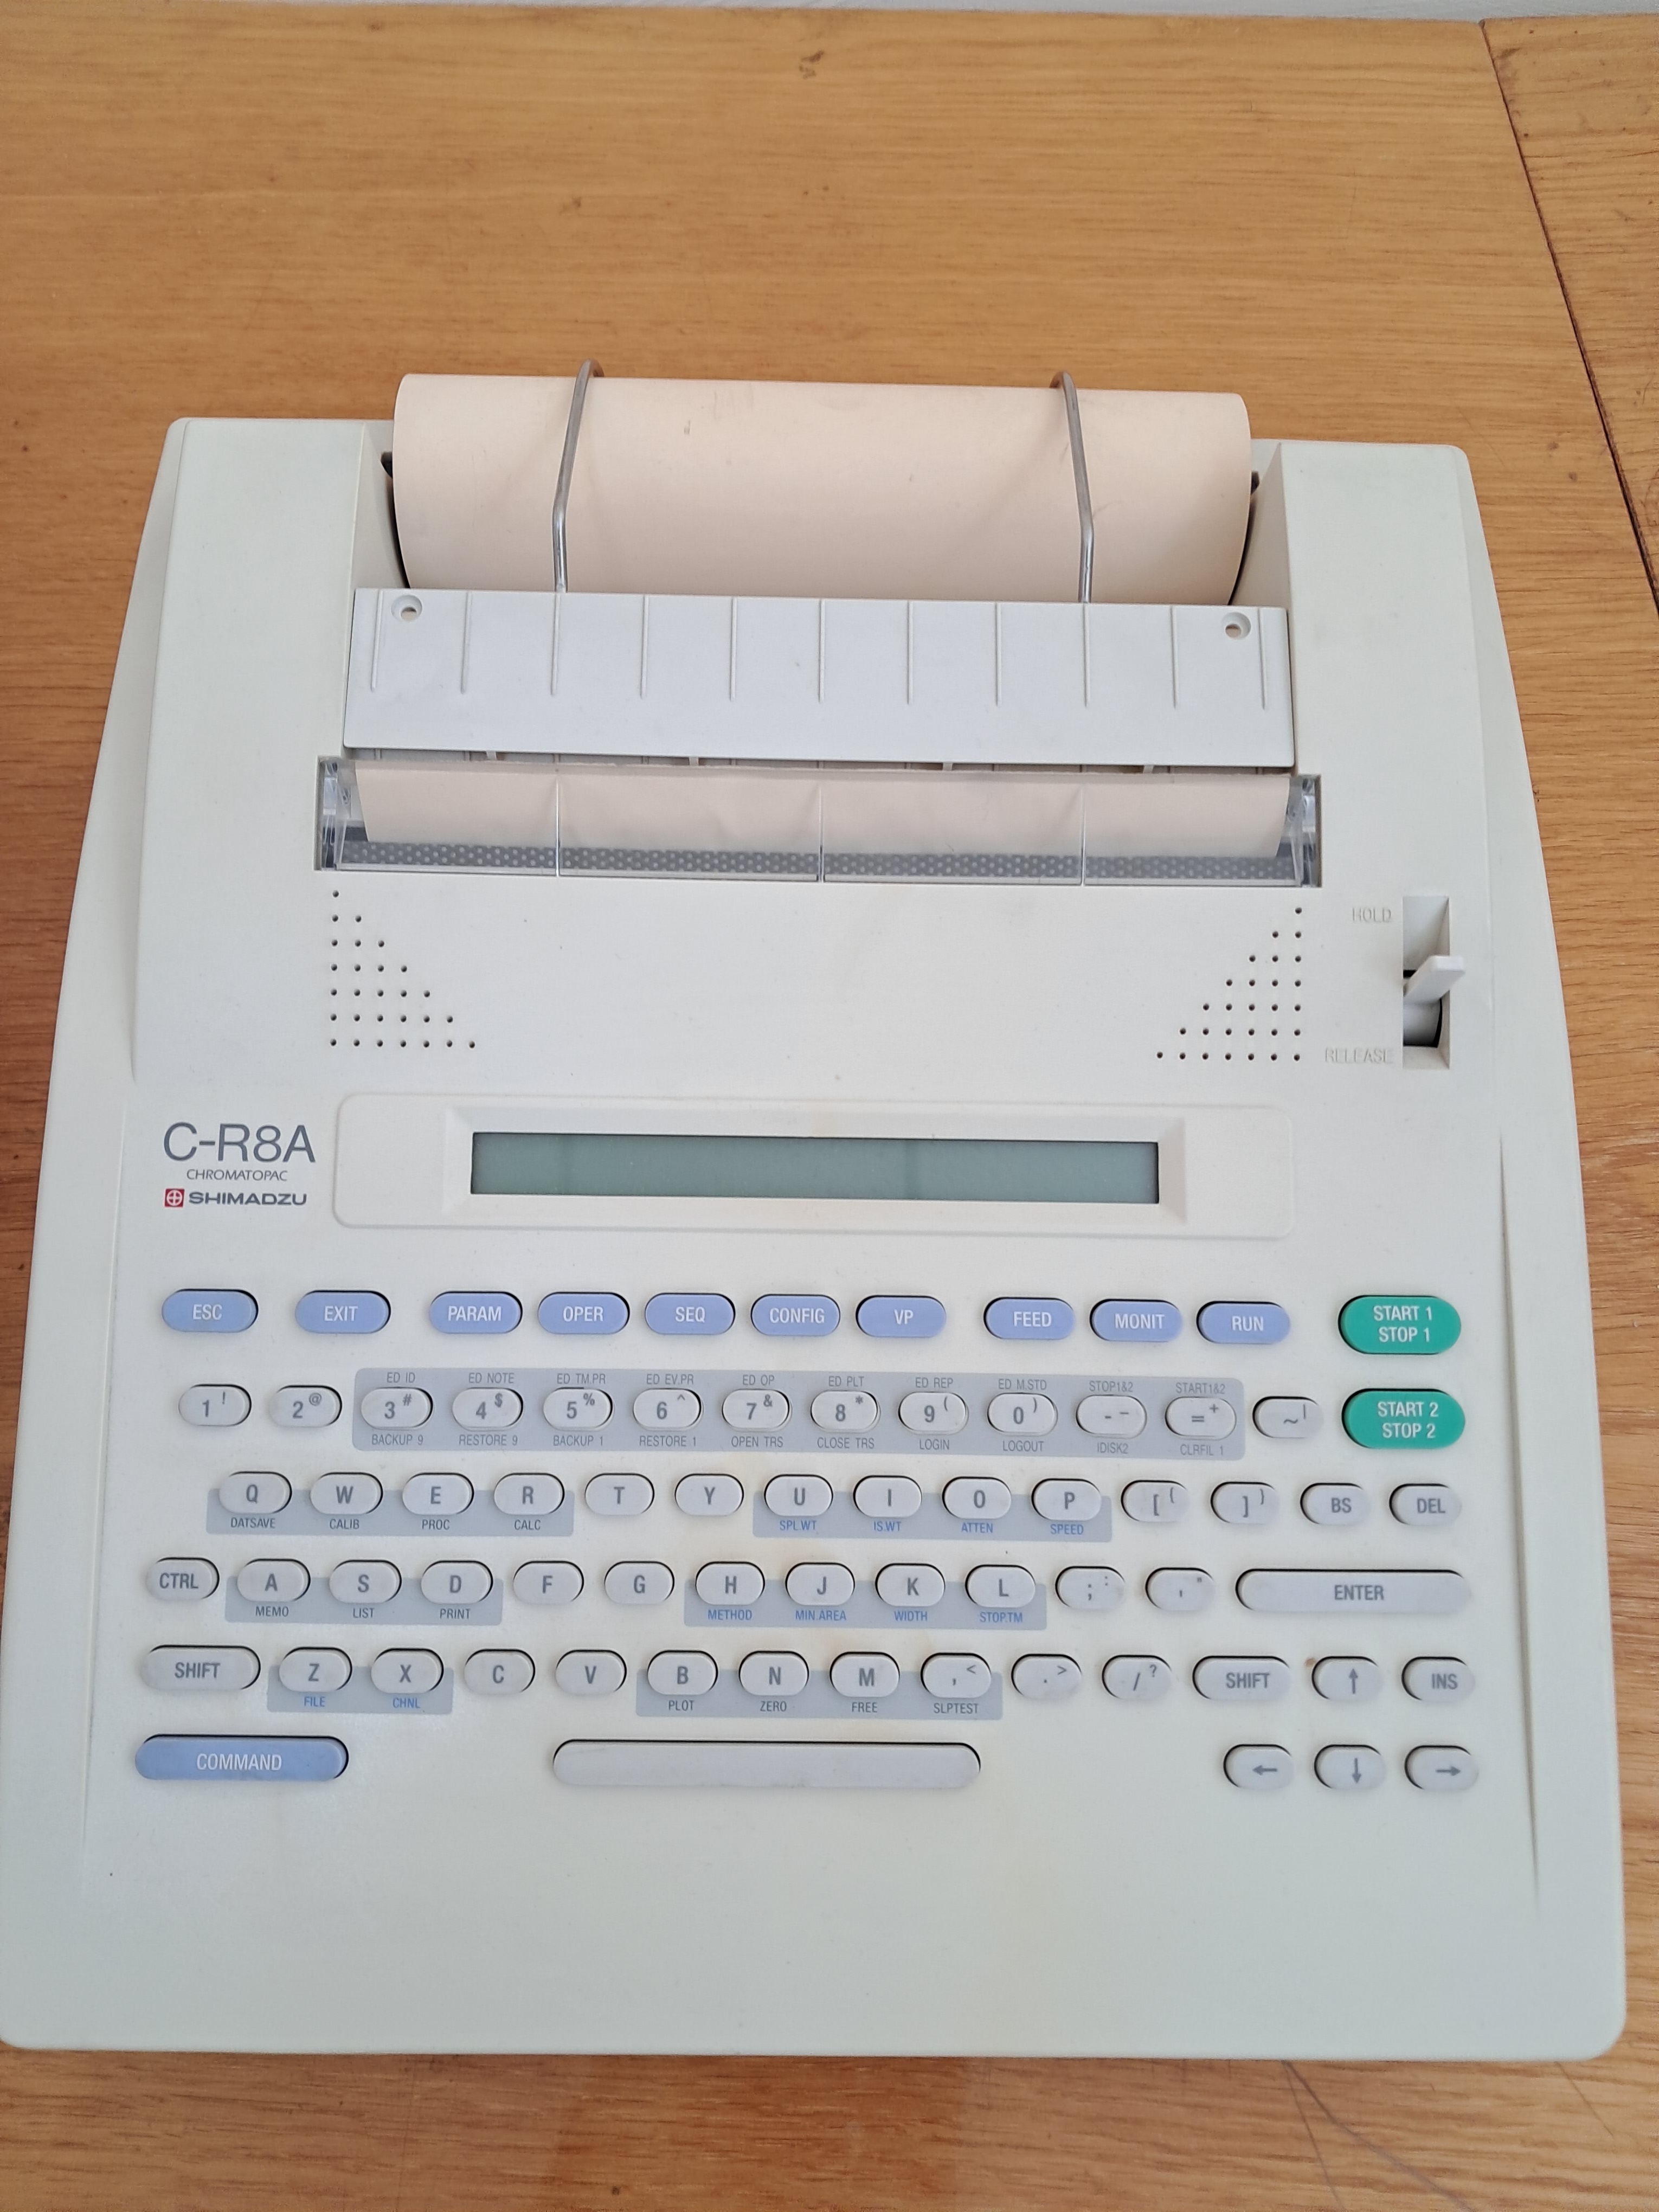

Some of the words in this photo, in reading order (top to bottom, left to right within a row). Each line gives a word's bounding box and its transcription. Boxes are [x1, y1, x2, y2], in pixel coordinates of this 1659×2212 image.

[1352, 907, 1391, 923] HOLD
[1325, 1047, 1393, 1063] RELEASE
[164, 1122, 316, 1162] C-R8A
[187, 1168, 288, 1181] CHROMATOPAC
[189, 1192, 307, 1205] SHIMADZU
[192, 1304, 222, 1321] ESC
[325, 1306, 358, 1322] EXIT
[448, 1306, 501, 1322] PARAM
[563, 1306, 604, 1322] OPER
[675, 1307, 706, 1323] SEQ
[769, 1308, 825, 1324] CONFIG
[894, 1309, 914, 1324] VP
[1013, 1311, 1052, 1327] FEED
[1373, 1306, 1422, 1321] START
[1426, 1307, 1432, 1322] 1
[1115, 1313, 1165, 1330] MONIT
[1231, 1315, 1264, 1332] RUN
[1378, 1326, 1419, 1342] STOP
[1423, 1327, 1430, 1342] 1
[387, 1373, 401, 1383] ED
[405, 1373, 415, 1383] ID
[468, 1373, 483, 1383] ED
[487, 1373, 515, 1384] NOTE
[557, 1373, 571, 1384] ED
[646, 1374, 660, 1384] ED
[742, 1374, 756, 1385] ED
[761, 1374, 775, 1385] OP
[828, 1376, 843, 1387] ED
[846, 1377, 864, 1387] PLT
[915, 1378, 929, 1388] ED
[934, 1378, 954, 1388] REP
[998, 1379, 1012, 1390] ED
[1089, 1381, 1133, 1392] STOP1&2
[1175, 1382, 1225, 1394] START1&2
[201, 1400, 210, 1417] 1
[292, 1402, 304, 1419] 2
[384, 1402, 396, 1419] 3
[475, 1402, 487, 1419] 4
[567, 1401, 577, 1419] 5
[656, 1402, 667, 1419] 6
[746, 1402, 757, 1420] 7
[835, 1404, 846, 1422] 8
[924, 1405, 935, 1423] 9
[1378, 1401, 1426, 1417] START
[1429, 1403, 1439, 1418] 2
[1382, 1423, 1422, 1439] STOP
[1425, 1424, 1436, 1439] 2
[372, 1433, 413, 1446] BACKUP
[417, 1435, 424, 1446] 9
[459, 1434, 507, 1446] RESTORE
[512, 1435, 519, 1446] 9
[553, 1435, 594, 1446] BACKUP
[599, 1436, 603, 1446] 1
[639, 1436, 687, 1447] RESTORE
[692, 1436, 696, 1447] 1
[731, 1437, 759, 1448] OPEN
[763, 1437, 784, 1448] TRS
[817, 1437, 850, 1449] CLOSE
[854, 1438, 875, 1449] TRS
[919, 1439, 950, 1450] LOGIN
[1002, 1441, 1044, 1452] LOGOUT
[1219, 1445, 1224, 1456] 1
[246, 1484, 259, 1504] Q
[336, 1486, 354, 1504] W
[430, 1486, 442, 1504] E
[522, 1486, 534, 1504] R
[613, 1487, 625, 1504] T
[704, 1487, 716, 1505] Y
[794, 1488, 806, 1506] U
[887, 1488, 892, 1507] I
[1064, 1491, 1075, 1509] P
[1331, 1497, 1352, 1514] BS
[1416, 1497, 1446, 1515] DEL
[230, 1517, 276, 1529] DATSAVE
[329, 1518, 360, 1530] CALIB
[421, 1519, 451, 1530] PROC
[514, 1519, 541, 1531] CALC
[961, 1522, 993, 1534] ATTEN
[1050, 1523, 1084, 1535] SPEED
[159, 1573, 199, 1590] CTRL
[265, 1573, 278, 1592] A
[357, 1574, 370, 1593] S
[449, 1575, 462, 1594] D
[542, 1575, 553, 1594] F
[633, 1575, 646, 1594] G
[724, 1575, 737, 1594] H
[817, 1576, 827, 1596] J
[906, 1577, 919, 1596] K
[999, 1578, 1009, 1597] L
[1334, 1585, 1384, 1601] ENTER
[255, 1605, 289, 1618] MEMO
[353, 1607, 375, 1619] LIST
[440, 1608, 470, 1620] PRINT
[708, 1609, 753, 1621] METHOD
[893, 1610, 928, 1622] WIDTH
[175, 1662, 220, 1679] SHIFT
[308, 1663, 319, 1682] Z
[400, 1664, 411, 1682] X
[492, 1664, 505, 1683] C
[584, 1666, 597, 1684] V
[677, 1666, 689, 1686] B
[768, 1667, 782, 1686] N
[858, 1668, 876, 1687] M
[1225, 1673, 1270, 1689] SHIFT
[1431, 1674, 1458, 1690] INS
[304, 1696, 325, 1708] FILE
[393, 1697, 421, 1709] CHNL
[668, 1700, 695, 1712] PLOT
[760, 1701, 787, 1712] ZERO
[852, 1702, 878, 1713] FREE
[933, 1703, 979, 1715] SLPTEST
[196, 1753, 282, 1772] COMMAND
